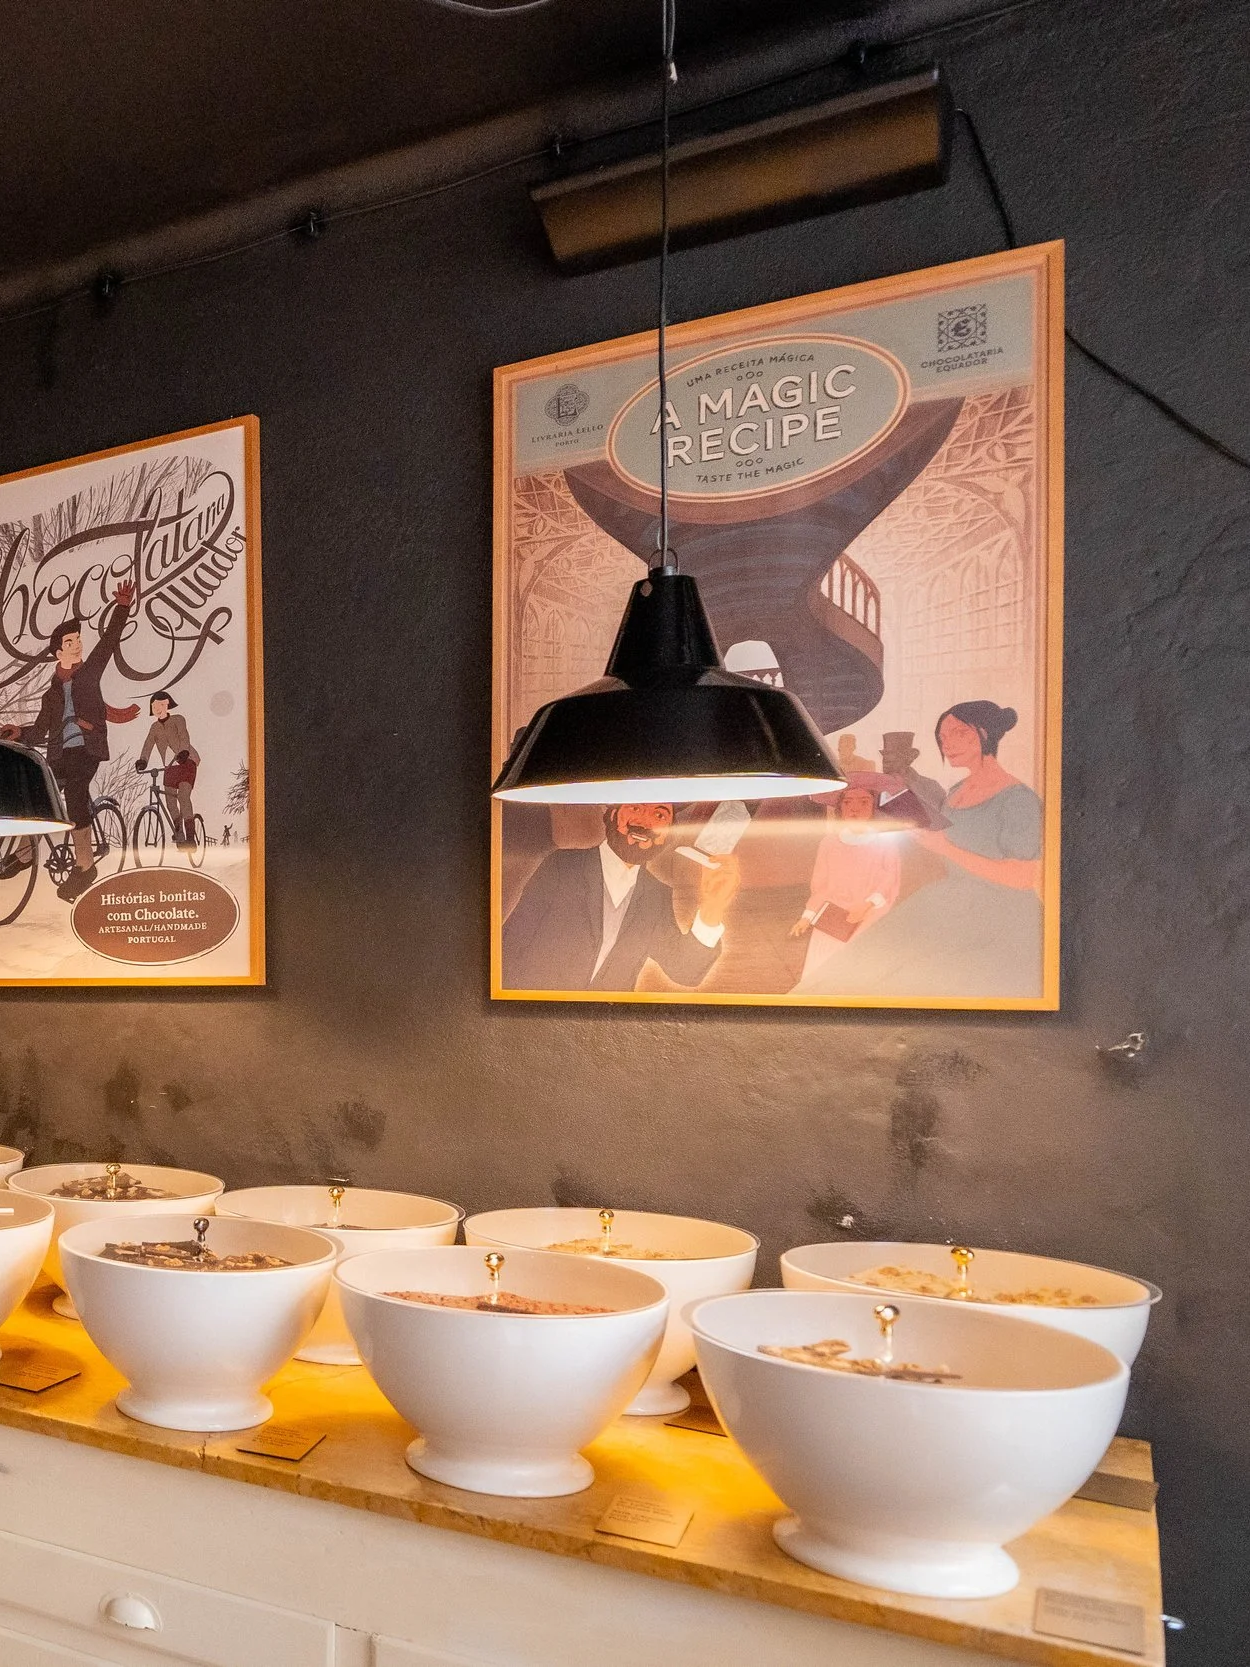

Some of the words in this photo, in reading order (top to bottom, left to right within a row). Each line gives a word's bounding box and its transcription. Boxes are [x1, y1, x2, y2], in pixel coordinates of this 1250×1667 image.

[921, 347, 1004, 369] CHOCOLATARIA
[936, 357, 988, 373] EQUADOR
[686, 373, 712, 388] UMA
[715, 357, 765, 376] RECEITA
[769, 352, 816, 364] MÁGICA
[650, 400, 683, 435] A
[697, 363, 857, 426] MAGIC
[531, 431, 573, 443] LIVRARIA
[576, 423, 604, 434] LELLO
[667, 404, 843, 469] RECIPE
[555, 438, 579, 447] PORTO
[695, 474, 733, 484] TASTE
[738, 469, 761, 479] THE
[765, 457, 805, 476] MAGIC
[100, 891, 155, 906] Histórias
[159, 889, 206, 903] bonitas
[106, 911, 132, 921] com
[134, 907, 199, 921] Chocolate.
[98, 922, 207, 934] ARTESANAL/HANDMADE
[127, 935, 176, 944] PORTUGAL
